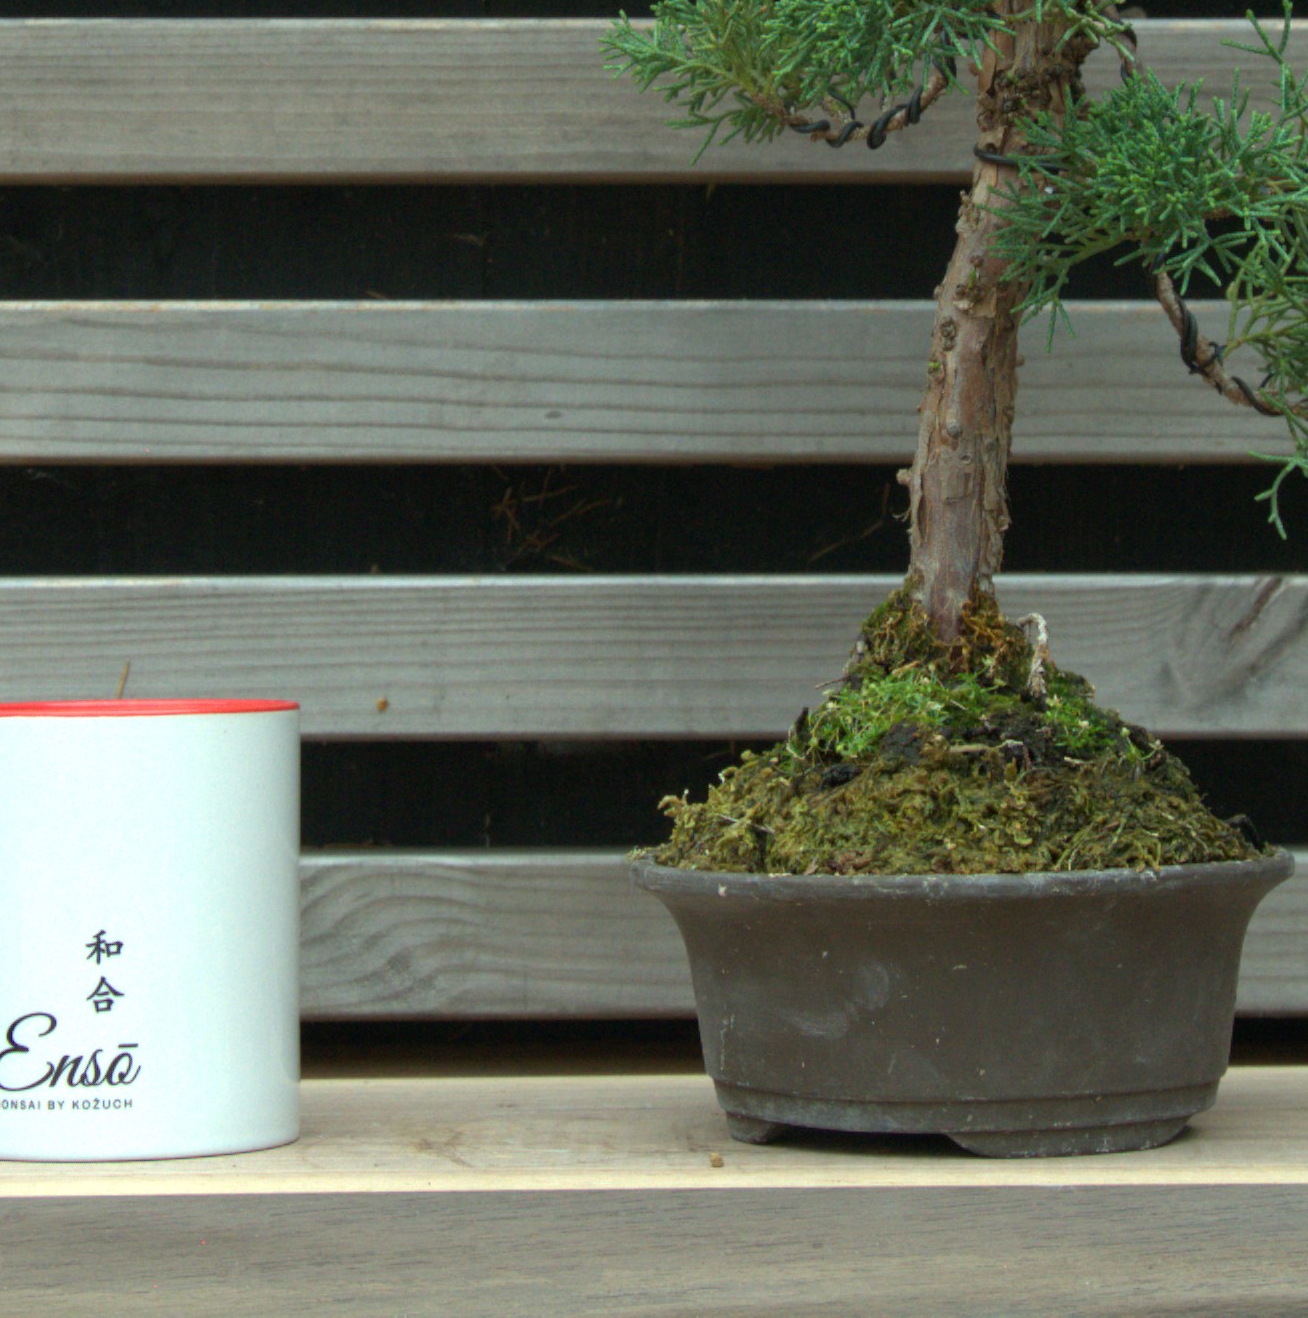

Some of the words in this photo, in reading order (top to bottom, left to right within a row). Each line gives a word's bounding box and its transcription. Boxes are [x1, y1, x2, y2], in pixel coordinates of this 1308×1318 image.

[85, 929, 125, 1014] 和合
[47, 1099, 66, 1111] BY
[71, 1096, 134, 1111] KOŽUCH
